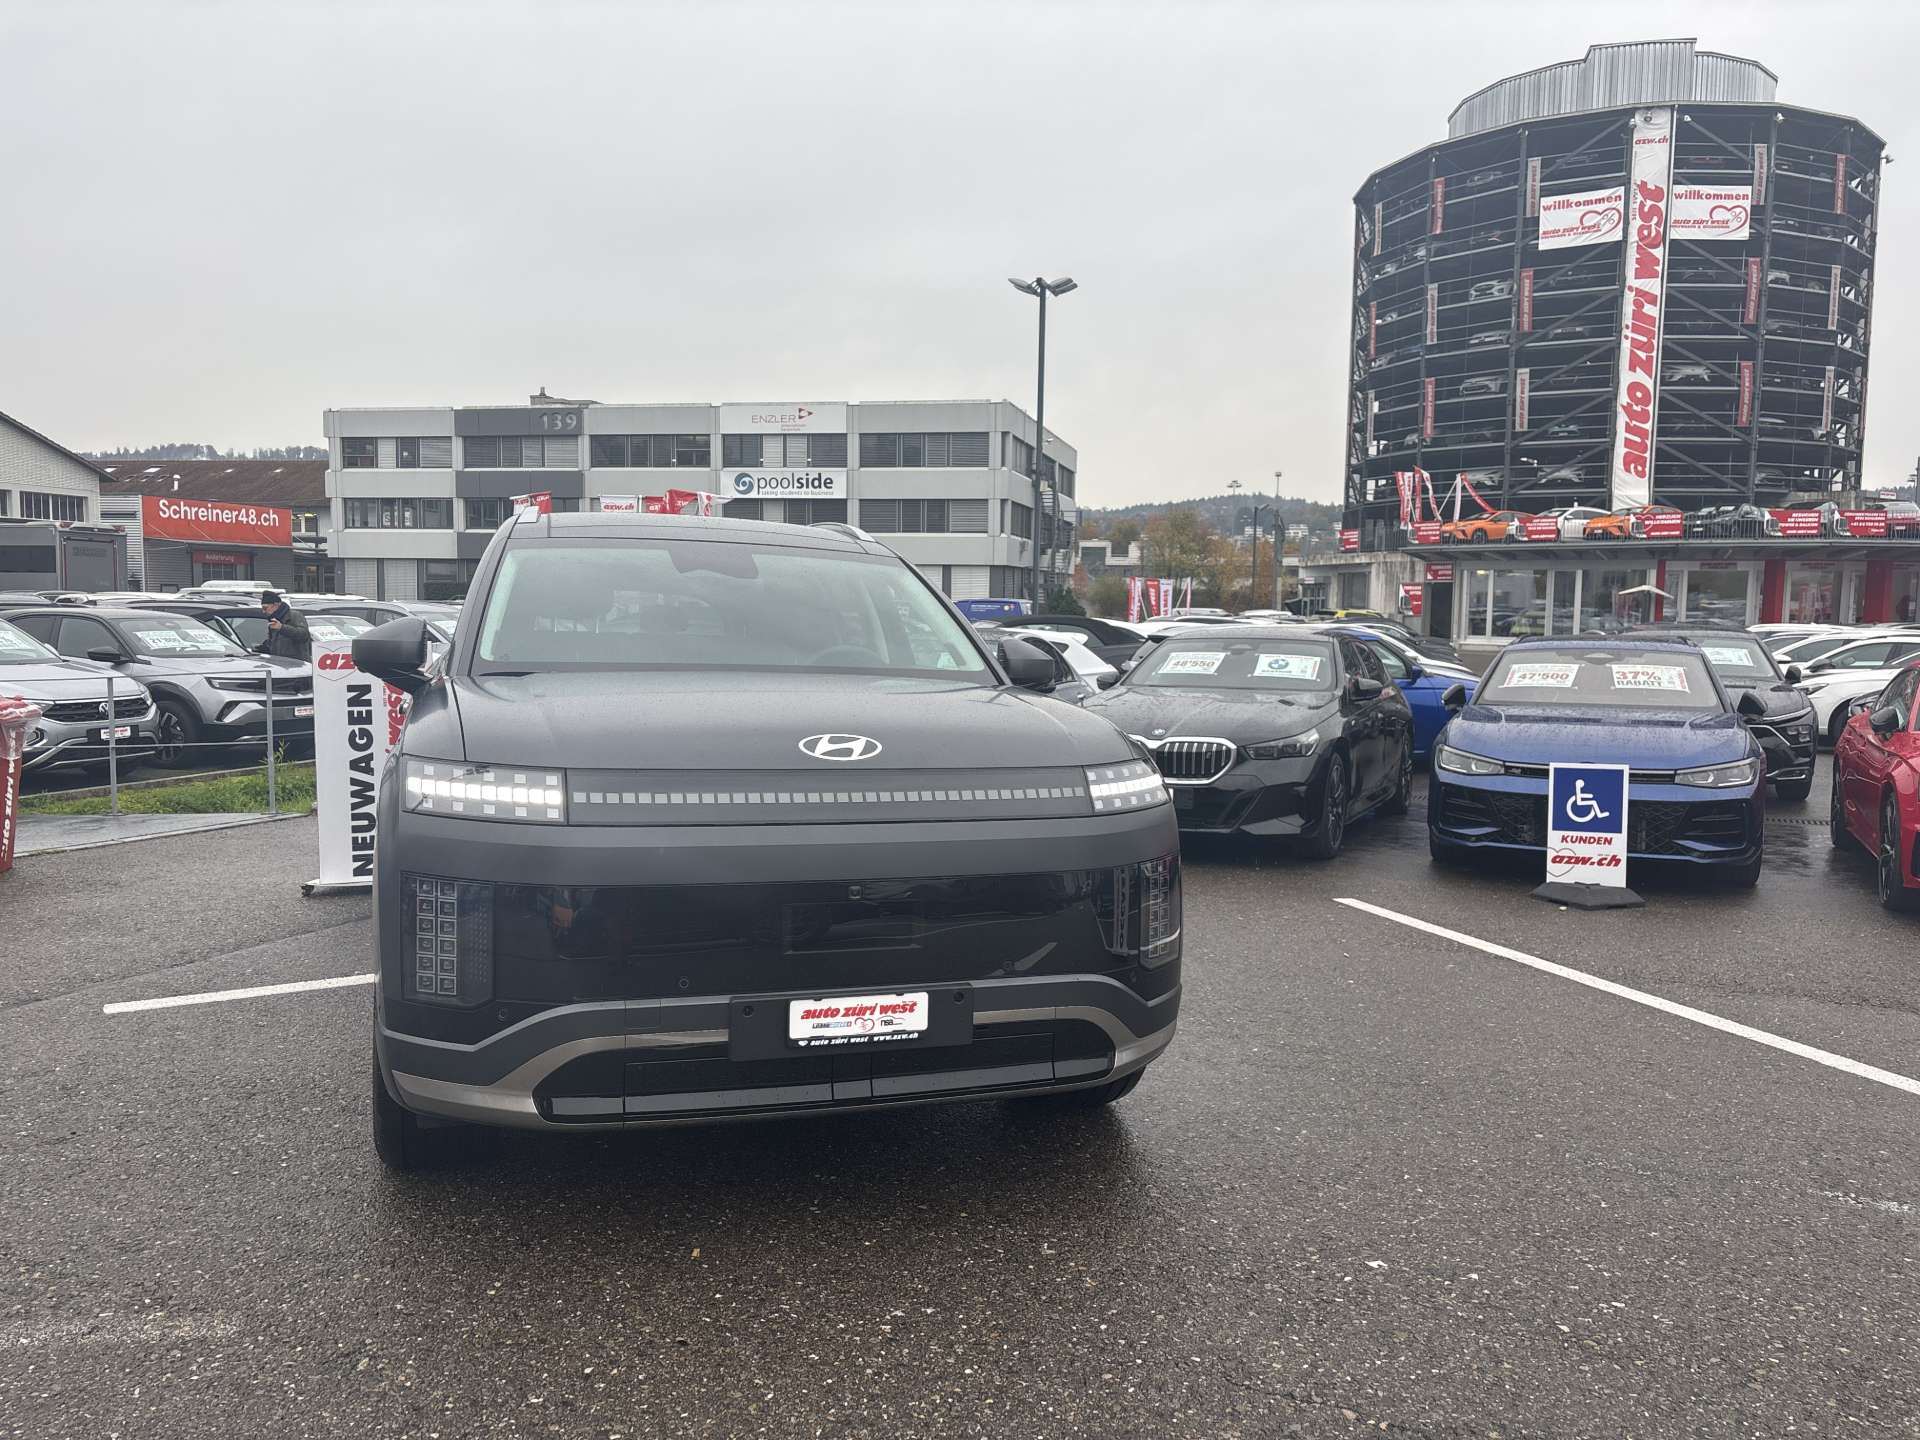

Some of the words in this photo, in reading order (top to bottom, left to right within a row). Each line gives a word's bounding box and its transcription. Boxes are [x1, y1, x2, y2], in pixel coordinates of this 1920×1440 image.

[1634, 135, 1669, 145] azw.ch
[1542, 194, 1622, 212] willkommen
[1674, 190, 1750, 201] willkommen
[1634, 180, 1666, 280] west
[1624, 285, 1660, 380] züri
[539, 413, 578, 431] 139
[751, 415, 797, 424] ENZLER
[1622, 381, 1653, 479] auto
[757, 472, 834, 496] poolside
[159, 499, 279, 527] Schreiner48.ch
[1518, 672, 1569, 681] 47'500
[1615, 671, 1661, 681] 37%
[347, 684, 377, 877] NEUWAGEN
[1560, 834, 1613, 846] KUNDEN
[1551, 854, 1622, 868] azw.ch
[800, 1006, 841, 1020] auto
[840, 1003, 878, 1018] züri
[879, 1001, 918, 1015] west
[830, 1037, 848, 1045] züri
[873, 1032, 919, 1042] www.azw.ch
